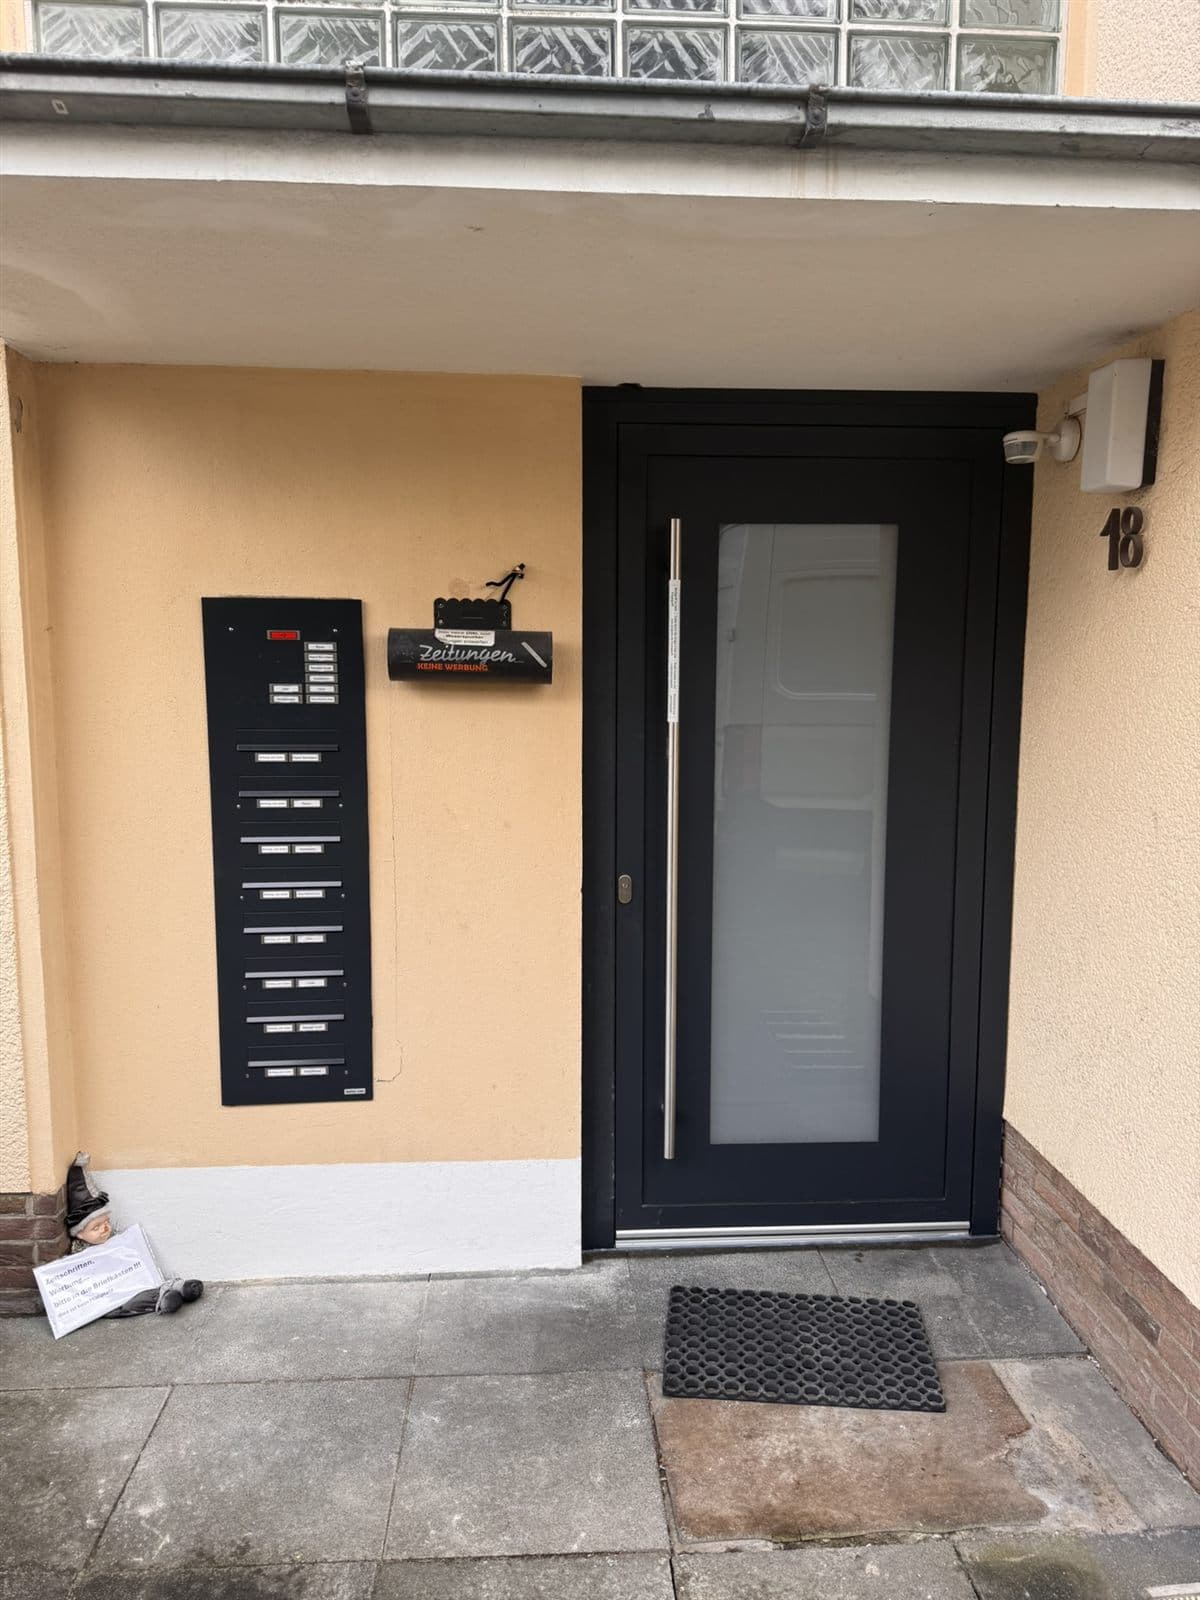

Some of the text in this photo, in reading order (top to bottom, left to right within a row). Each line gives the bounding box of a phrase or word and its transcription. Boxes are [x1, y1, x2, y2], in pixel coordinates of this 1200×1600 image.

[1099, 506, 1144, 571] 18
[416, 663, 489, 672] KEINE WERBUNG
